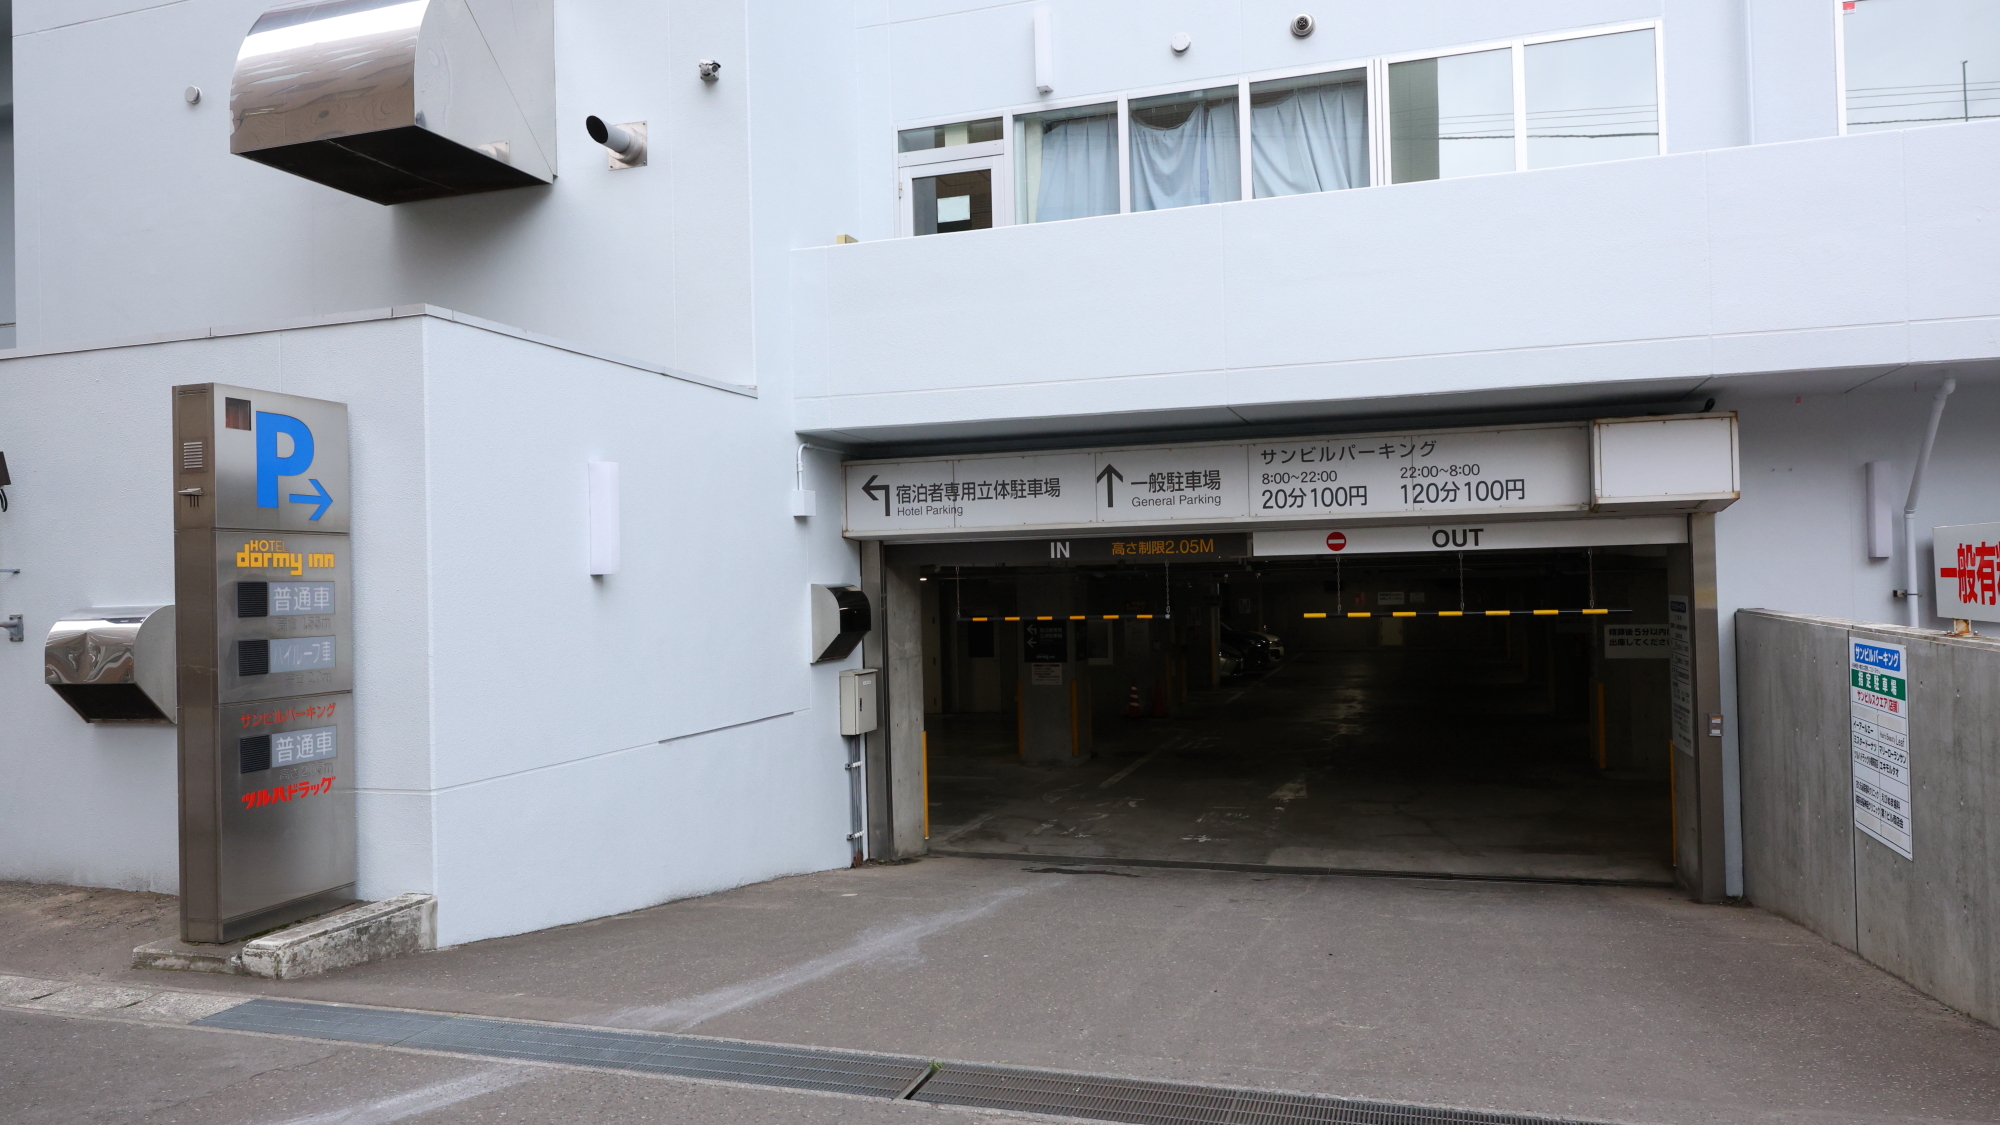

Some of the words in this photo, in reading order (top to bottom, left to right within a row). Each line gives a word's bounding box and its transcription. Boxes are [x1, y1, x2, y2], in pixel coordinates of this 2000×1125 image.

[256, 411, 314, 508] P
[1261, 441, 1437, 465] サンビルパーキング
[896, 477, 1061, 505] 宿泊者専用立体駐車場
[1130, 469, 1221, 494] 一般駐車場
[1400, 478, 1526, 504] 120分100円
[1131, 495, 1175, 508] General
[1179, 493, 1221, 507] Parking
[1261, 485, 1368, 510] 20分100円
[897, 506, 923, 517] Hotel
[926, 504, 963, 517] Parking
[250, 539, 289, 552] HOTEL
[1050, 541, 1070, 559] IN
[1111, 538, 1214, 556] 高さ制限2.05M
[1431, 528, 1484, 548] OUT
[236, 544, 302, 576] dormy
[308, 553, 335, 568] inn
[1940, 541, 2000, 606] 一般有
[273, 586, 331, 612] 普通車
[273, 641, 332, 666] ハイルーフ車
[240, 702, 337, 728] サンビルパーキング
[275, 731, 333, 763] 普通車
[241, 776, 337, 810] ツルハドラッグ
